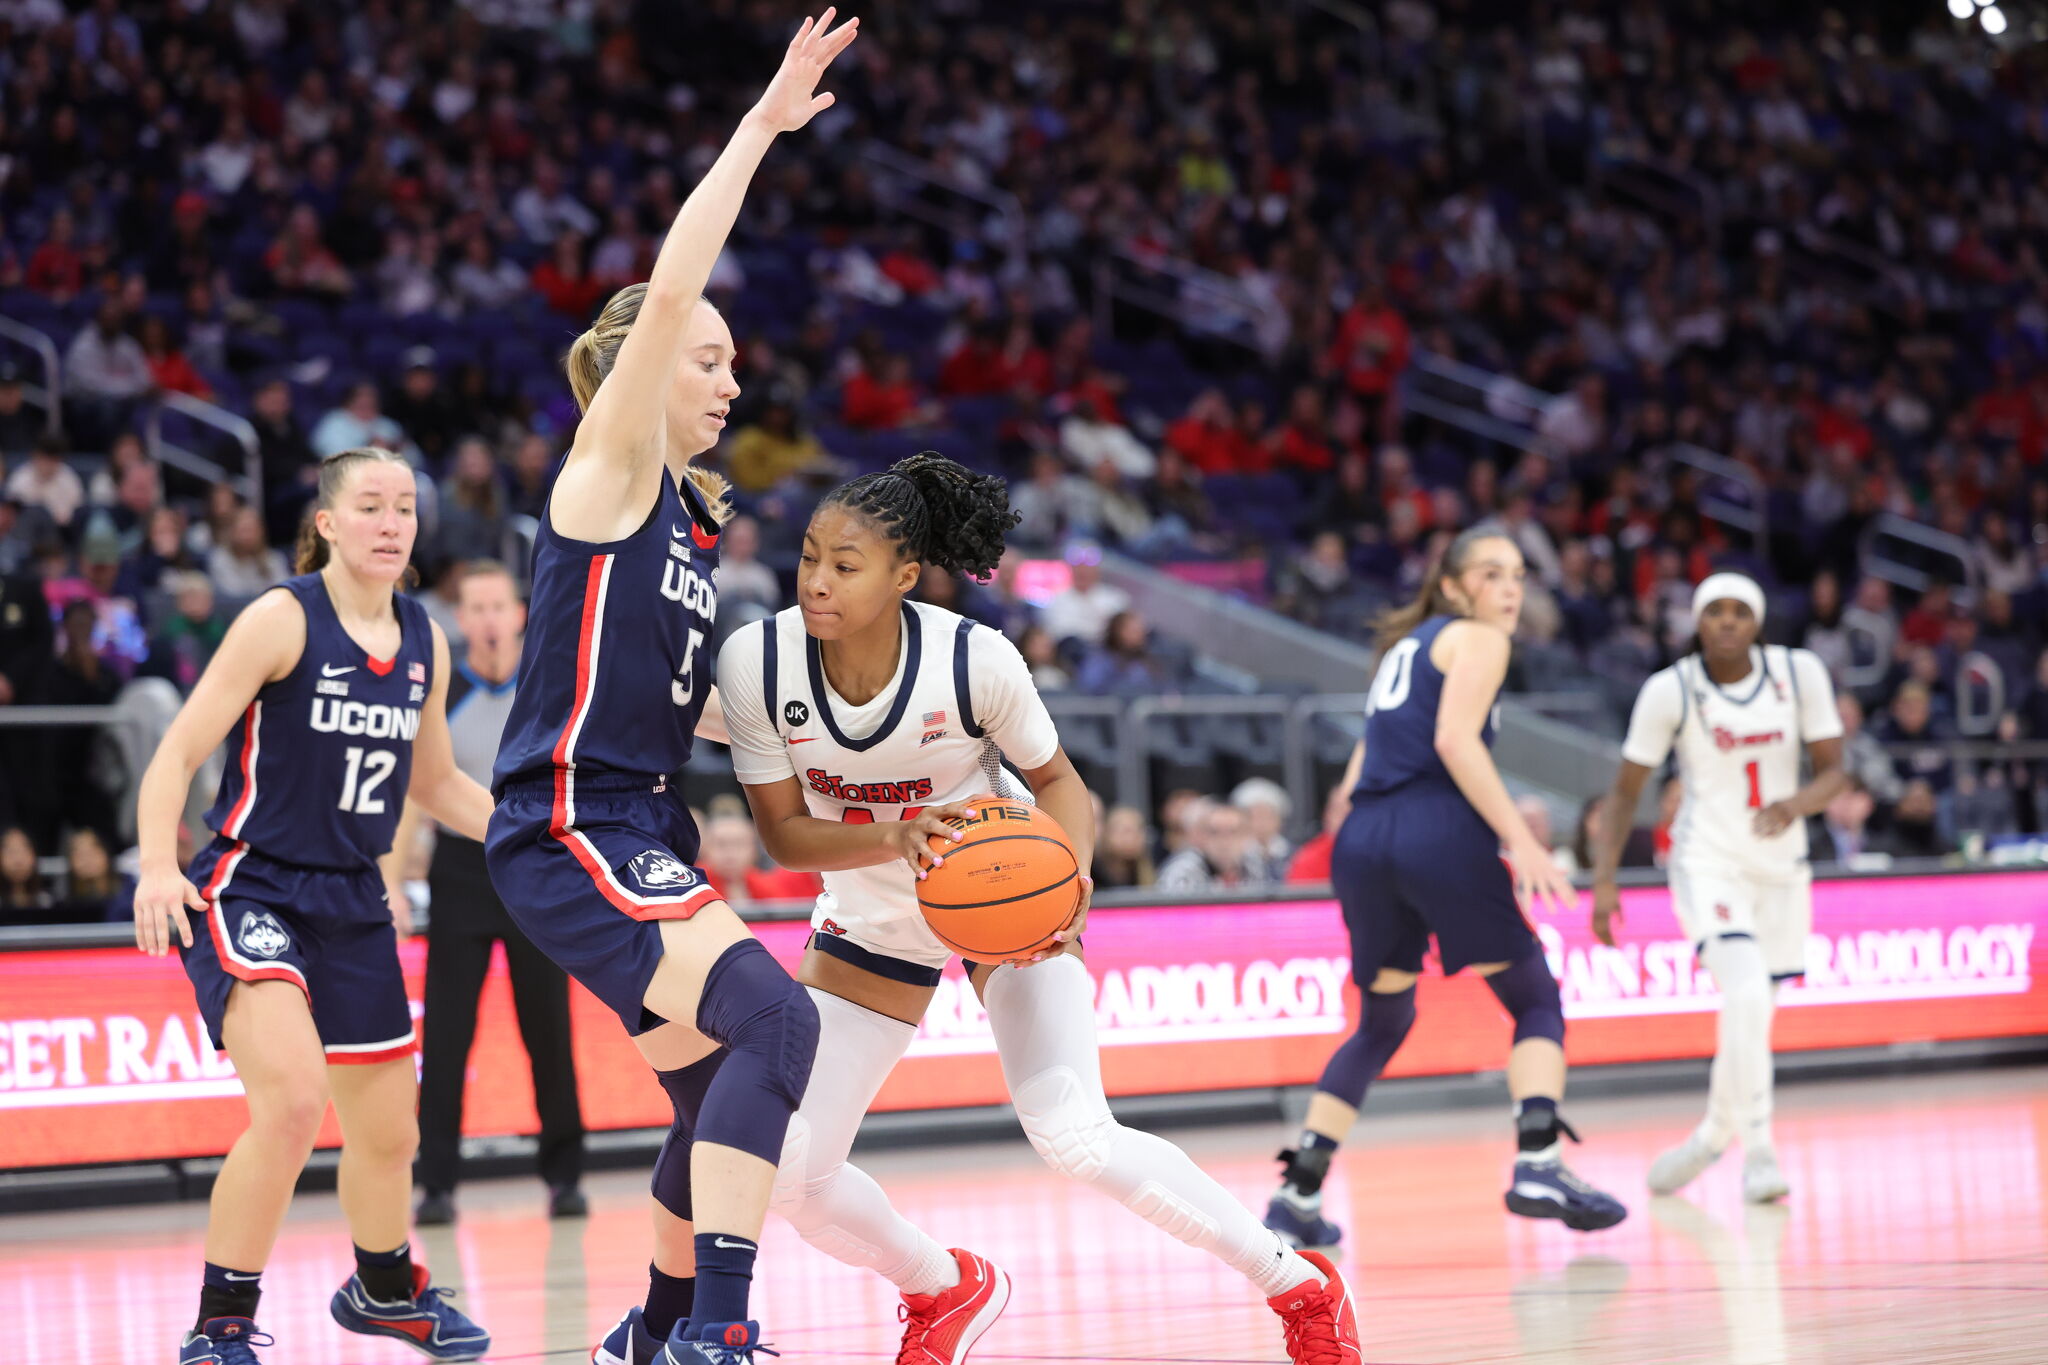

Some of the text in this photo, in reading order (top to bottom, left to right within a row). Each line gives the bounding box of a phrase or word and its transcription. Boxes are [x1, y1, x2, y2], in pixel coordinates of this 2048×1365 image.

[660, 558, 718, 627] UCON
[671, 628, 705, 707] 5
[786, 706, 806, 720] JK
[337, 746, 398, 814] 12
[1745, 761, 1761, 808] 1
[1804, 921, 2035, 986] RADIOLOGY
[1087, 956, 1351, 1028] ADIOLOGY
